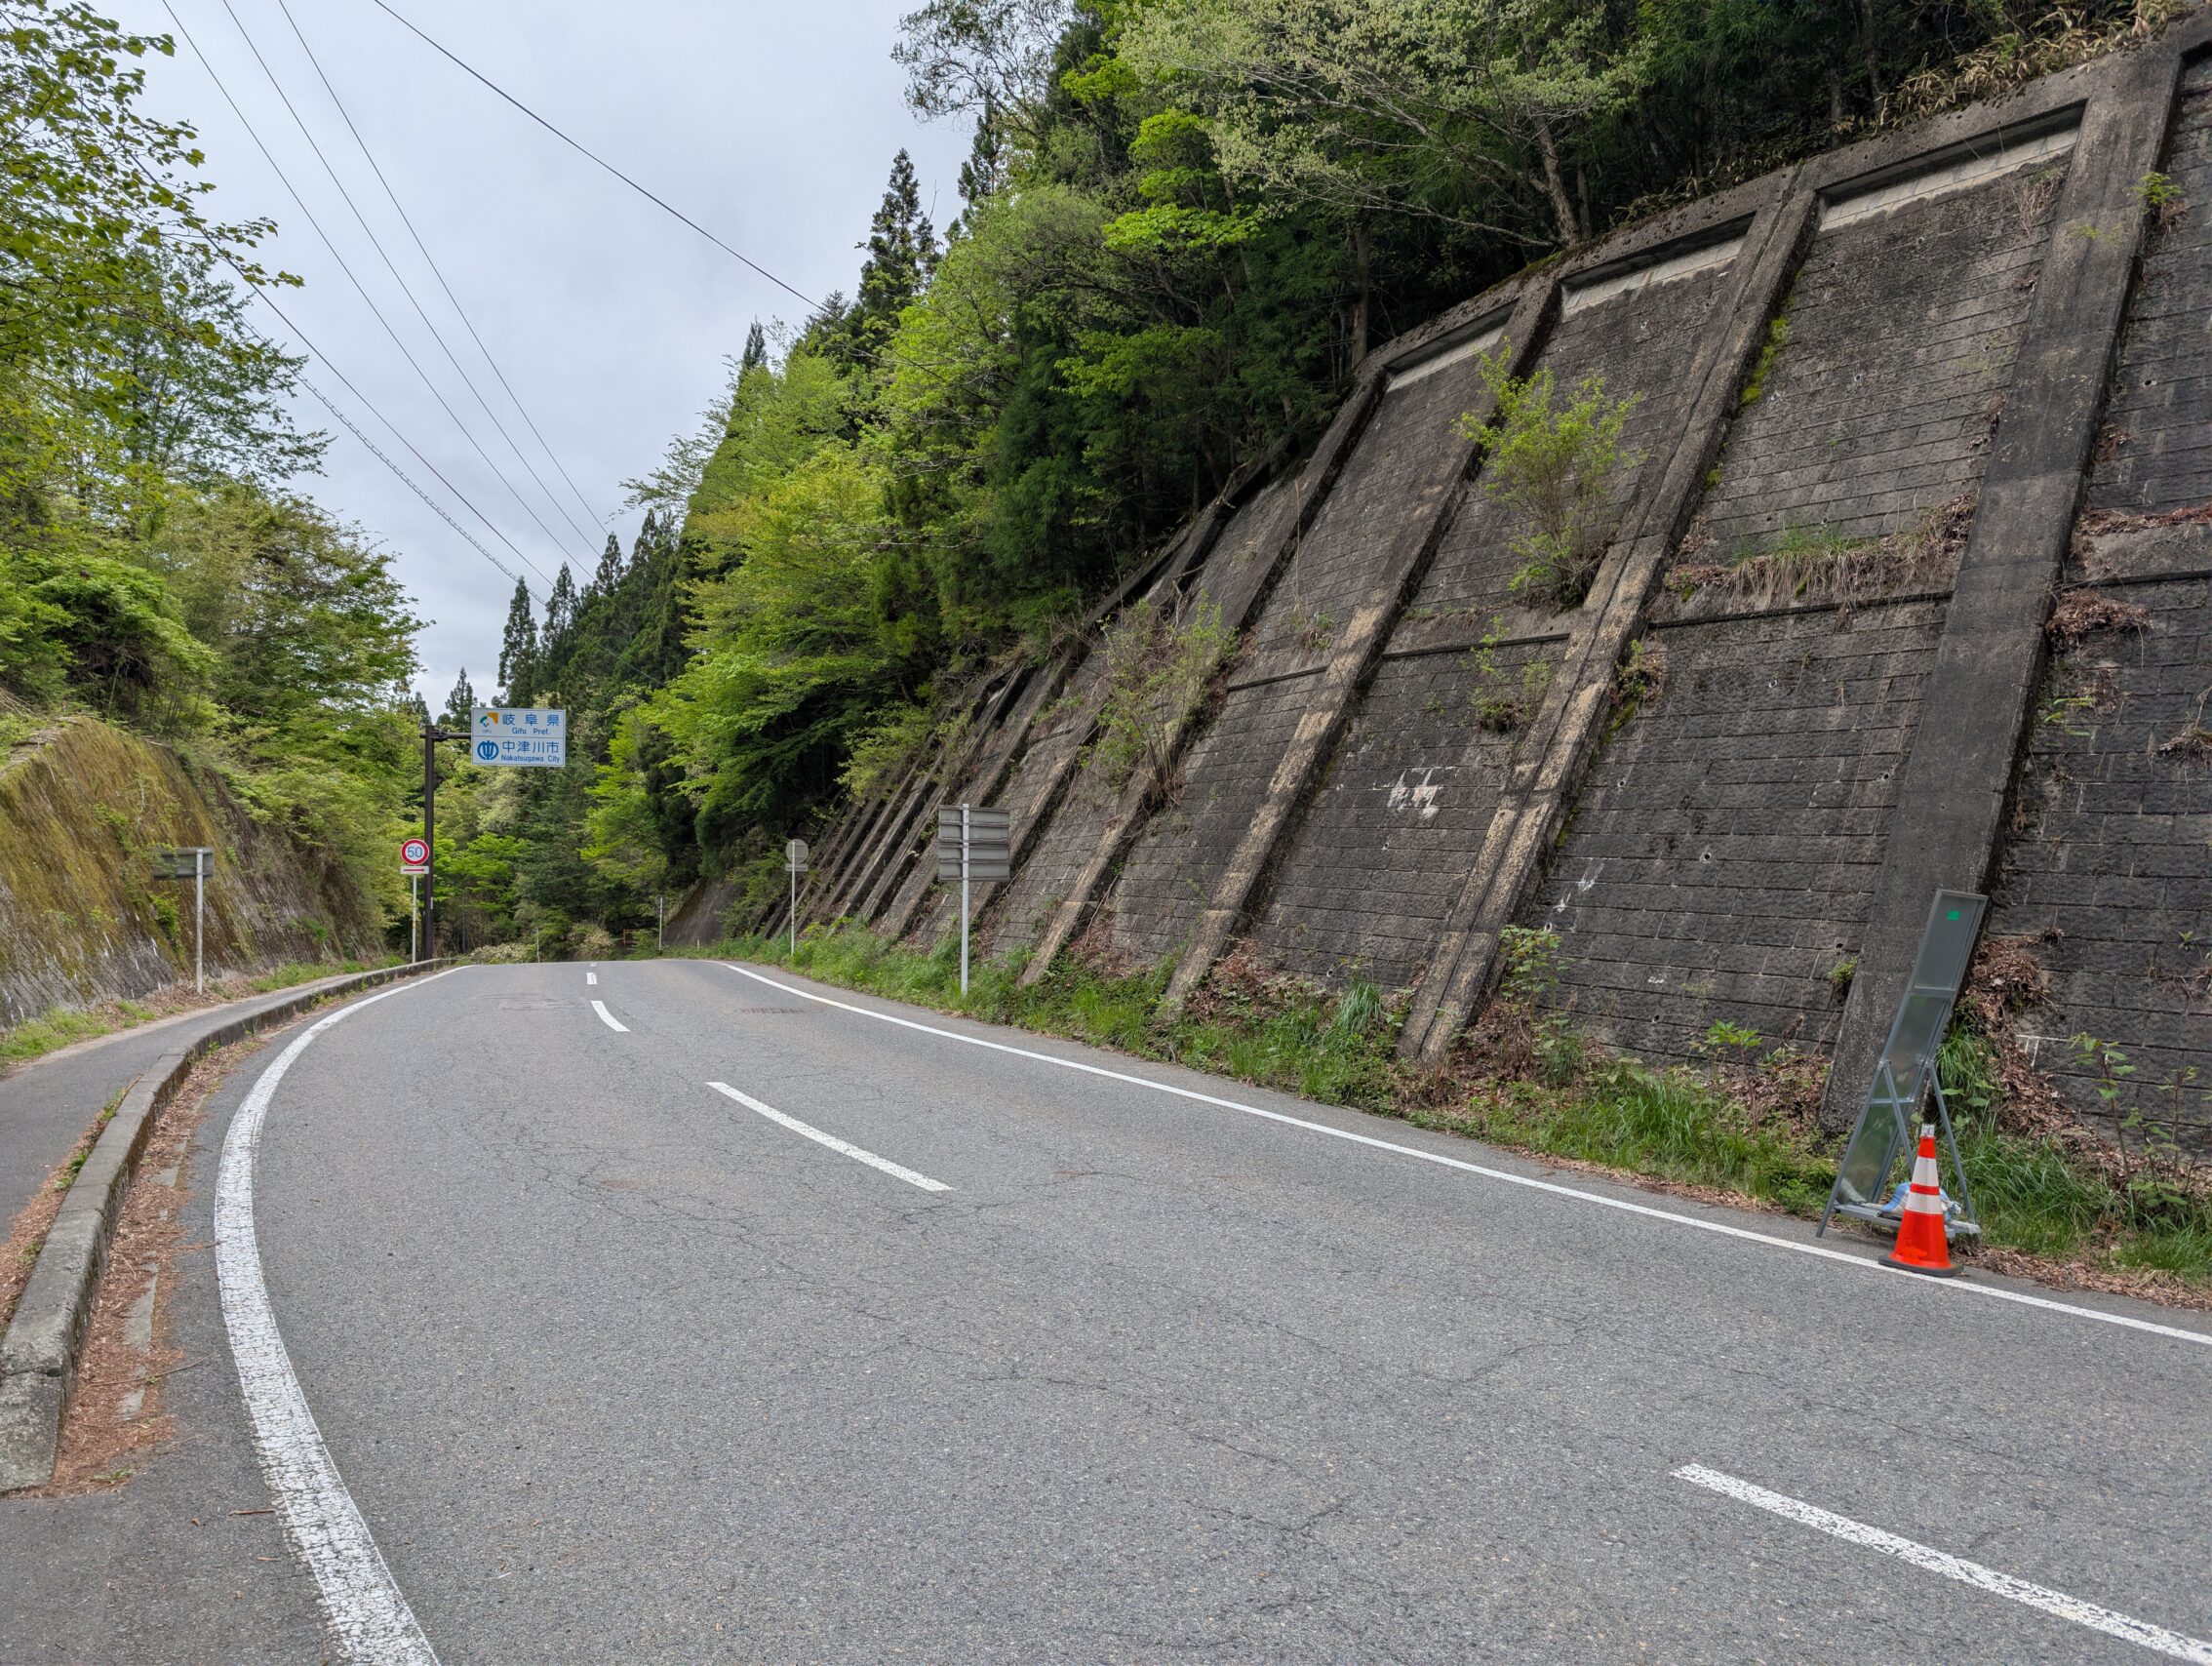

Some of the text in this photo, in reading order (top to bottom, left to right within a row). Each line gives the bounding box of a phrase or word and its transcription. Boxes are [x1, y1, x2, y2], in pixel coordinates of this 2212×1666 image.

[502, 713, 560, 726] 岐阜県
[502, 739, 559, 753] 中津川市
[407, 847, 422, 857] 50
